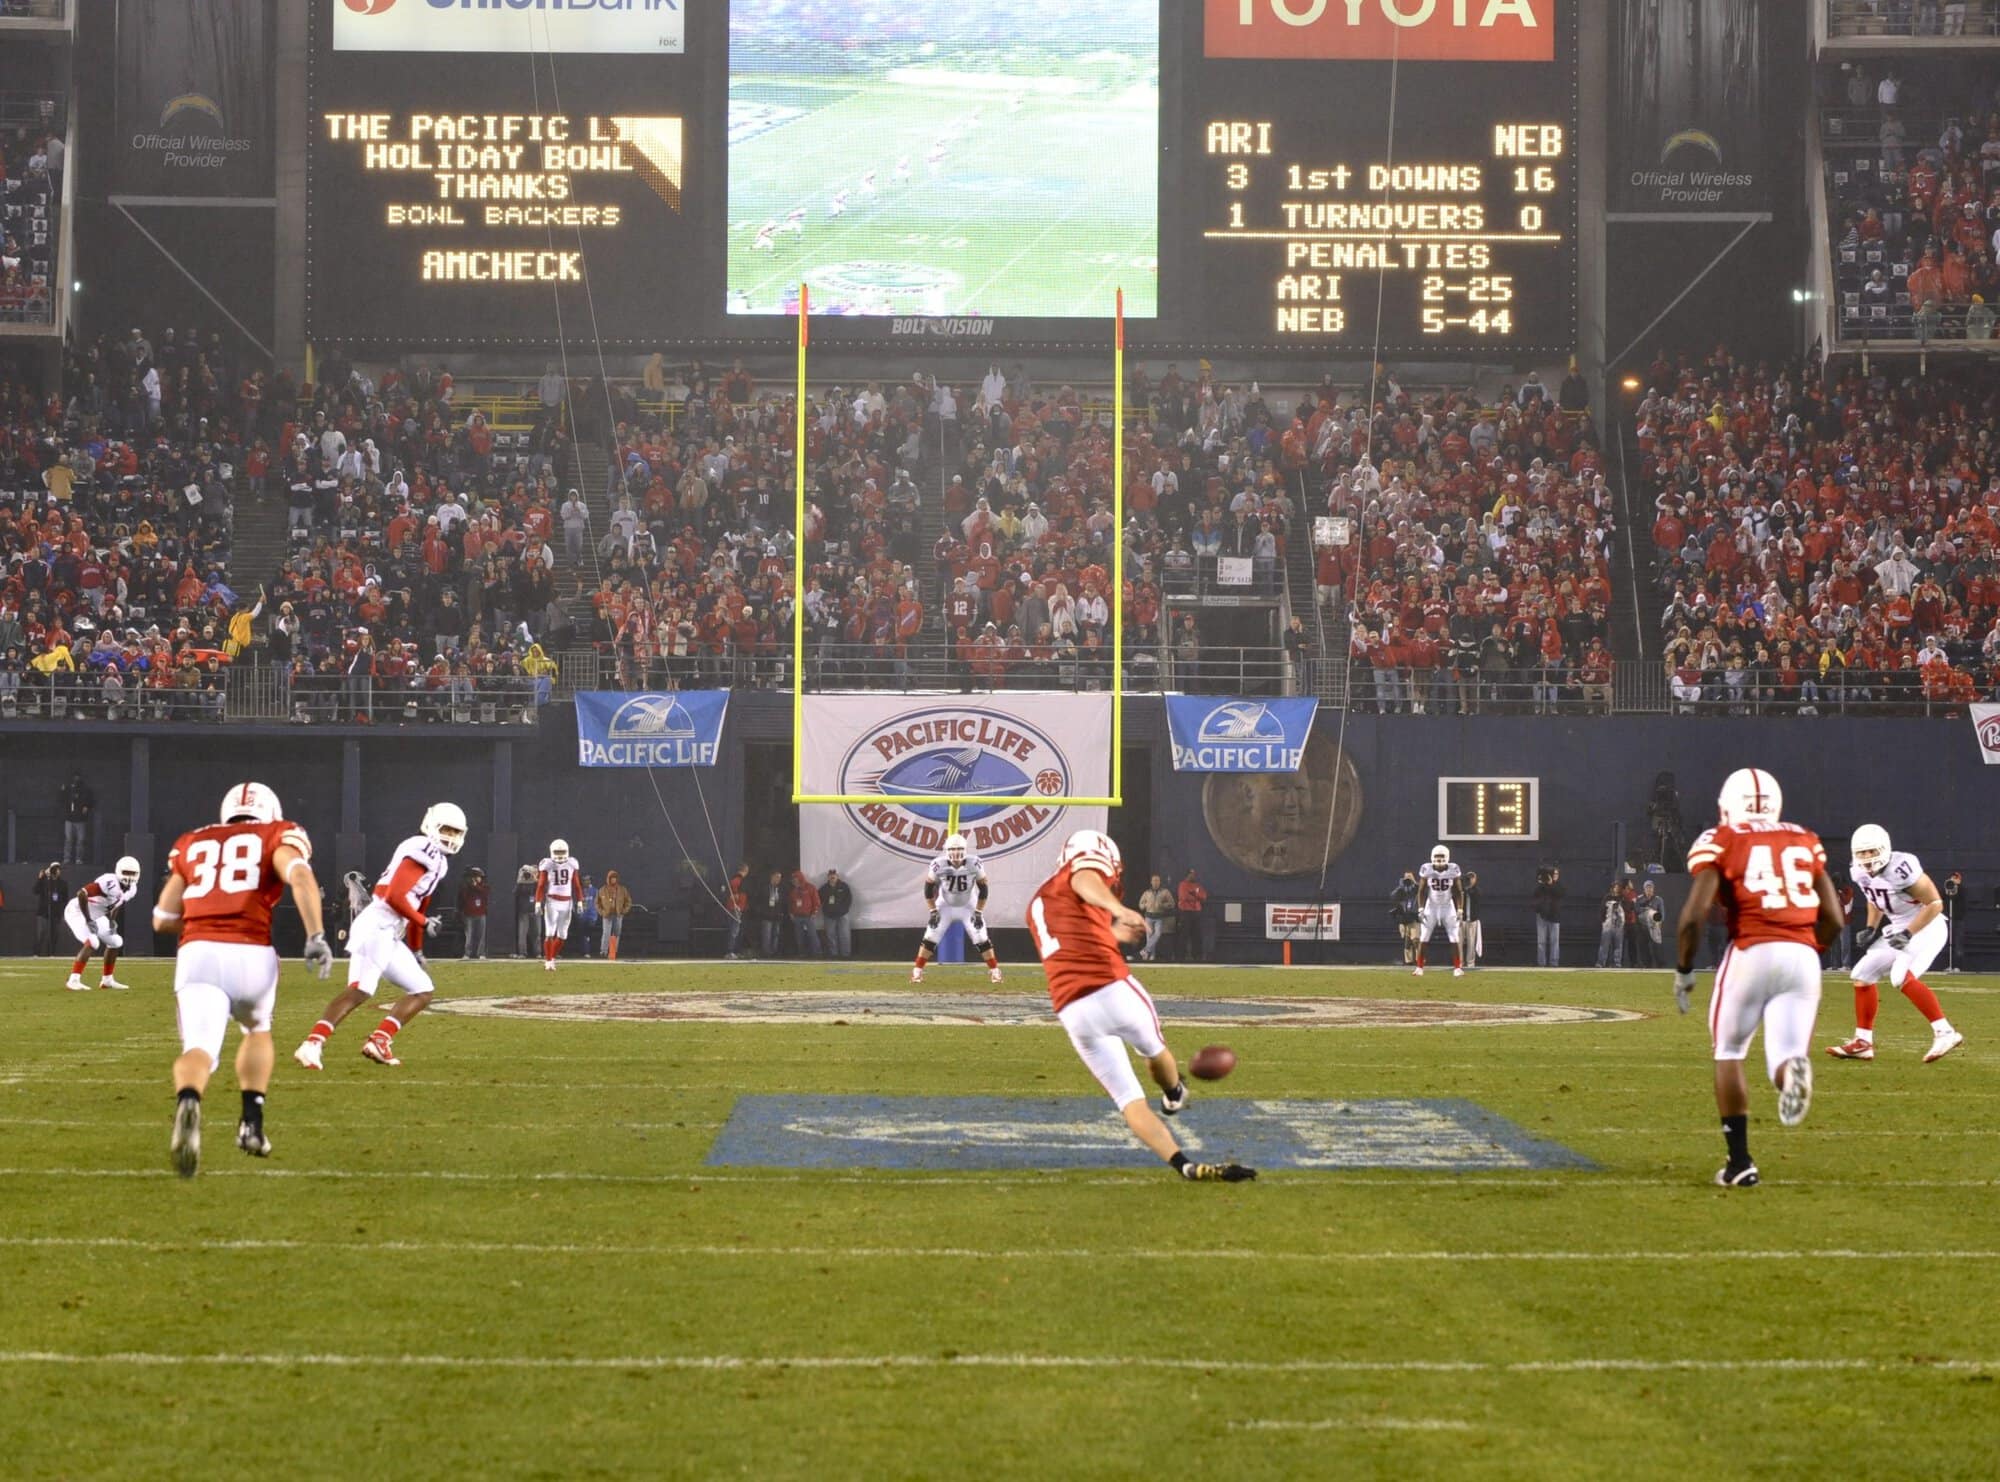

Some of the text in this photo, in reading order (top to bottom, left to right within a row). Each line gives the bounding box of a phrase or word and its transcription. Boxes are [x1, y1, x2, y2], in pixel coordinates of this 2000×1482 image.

[325, 114, 391, 140] THE
[411, 115, 569, 141] PACIFIC
[1207, 122, 1562, 157] ARI NEB
[132, 134, 251, 151] Official Wireless
[163, 152, 226, 168] Provider
[366, 144, 633, 171] HOLIDAY BOWL
[435, 174, 569, 199] THANKS
[1227, 164, 1555, 192] 3 1st DOWNS 16
[1631, 171, 1752, 186] Official Wireless
[1661, 187, 1723, 202] Provider
[388, 205, 620, 226] BOWL BACKERS
[1229, 202, 1542, 230] 1 TURNOVERS 0
[422, 251, 581, 280] AMCHECK
[1287, 243, 1490, 269] PENALTIES
[1277, 275, 1513, 301] ARI 2-25
[891, 318, 994, 336] BOLT VISION
[1277, 308, 1513, 334] NEB 5-44
[954, 600, 968, 616] 12
[579, 739, 714, 764] PACIFIC LIF
[871, 718, 1037, 762] PACIFIC LIFE
[1173, 744, 1301, 769] PACIFIC LIF
[1477, 783, 1522, 834] 13
[973, 804, 1050, 850] BOWL
[182, 833, 263, 899] 38
[553, 869, 569, 886] 19
[1743, 845, 1821, 909] 46
[1894, 860, 1913, 880] 37
[946, 875, 968, 892] 76
[1031, 896, 1061, 960] 1
[1272, 907, 1333, 925] ESPN
